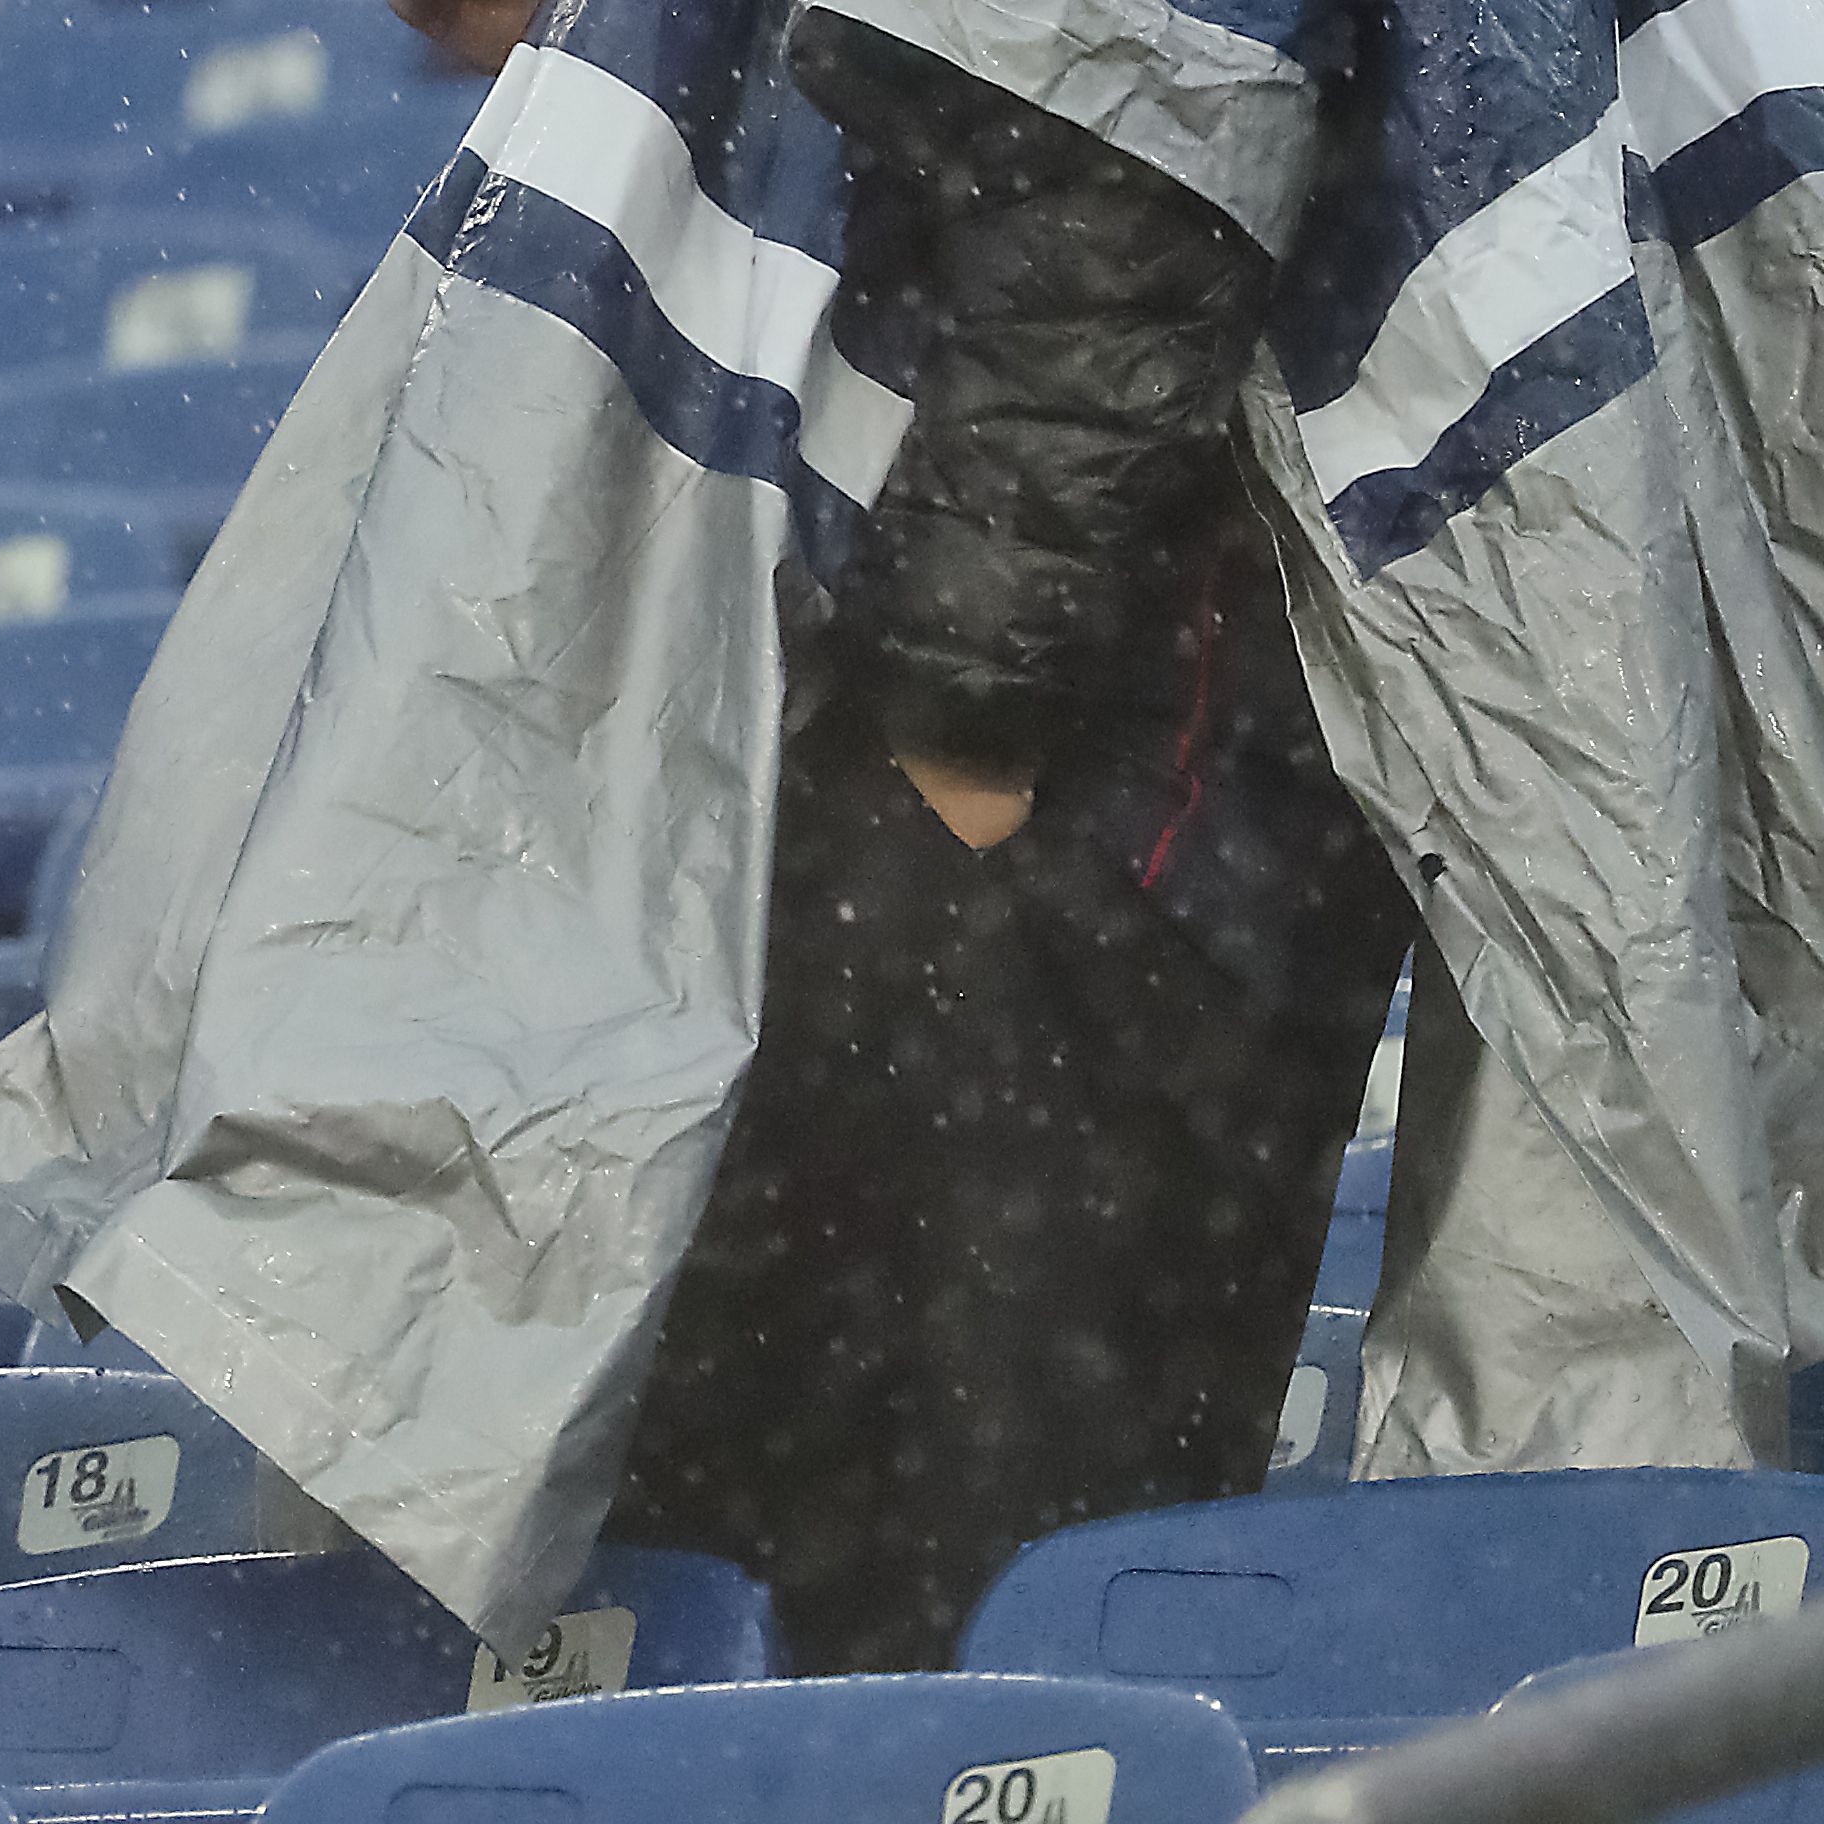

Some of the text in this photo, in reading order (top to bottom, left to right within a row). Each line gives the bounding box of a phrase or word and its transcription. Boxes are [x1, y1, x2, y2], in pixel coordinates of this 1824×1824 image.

[36, 1450, 109, 1509] 18
[1645, 1553, 1732, 1616] 20
[954, 1767, 1038, 1824] 20
